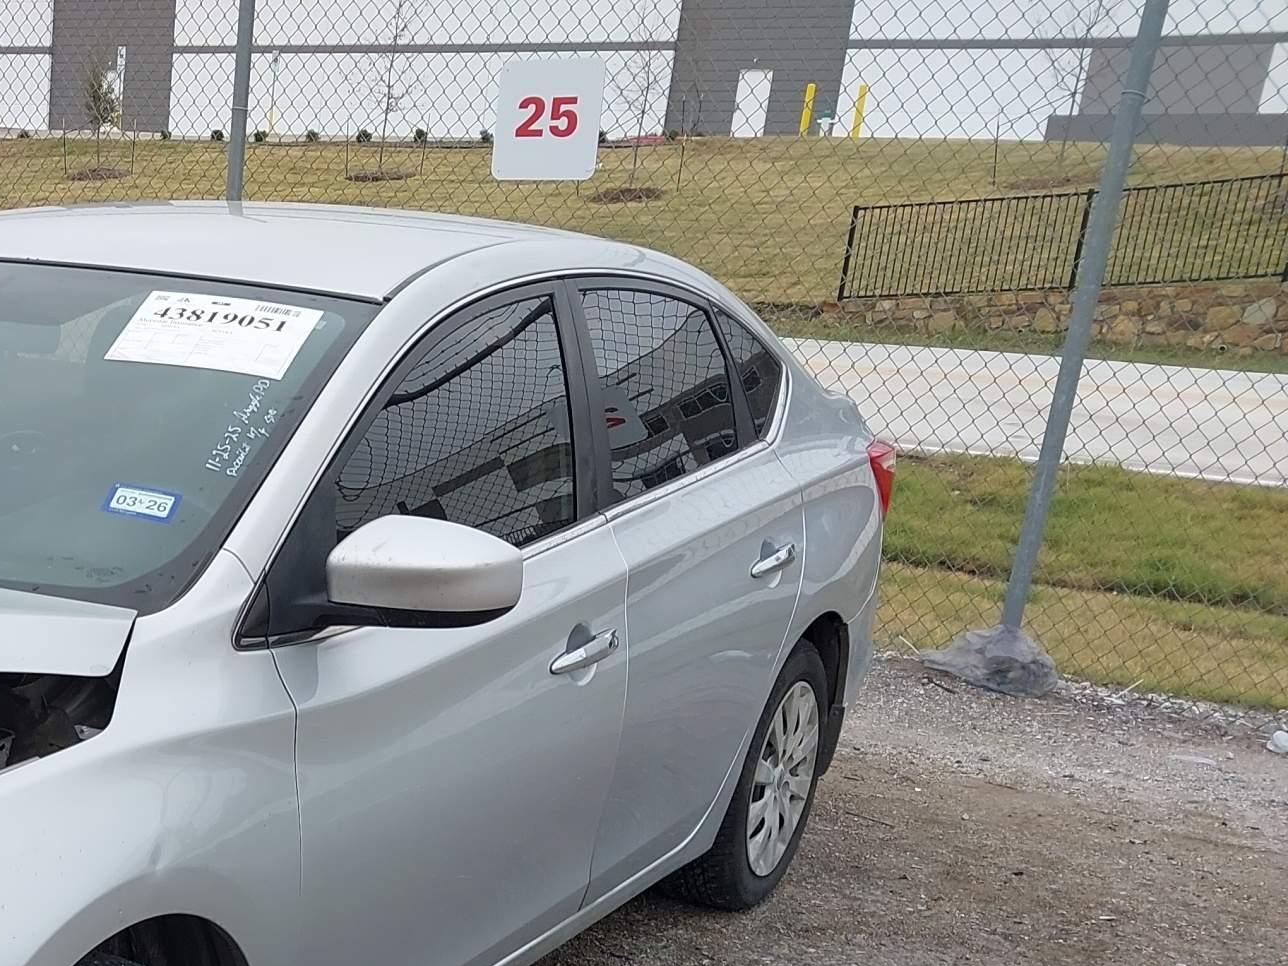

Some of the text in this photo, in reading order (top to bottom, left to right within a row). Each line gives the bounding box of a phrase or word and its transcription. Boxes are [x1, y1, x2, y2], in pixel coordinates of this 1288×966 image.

[514, 95, 579, 139] 25
[153, 306, 288, 333] 43819051
[115, 494, 138, 508] 03
[145, 499, 168, 513] 26
